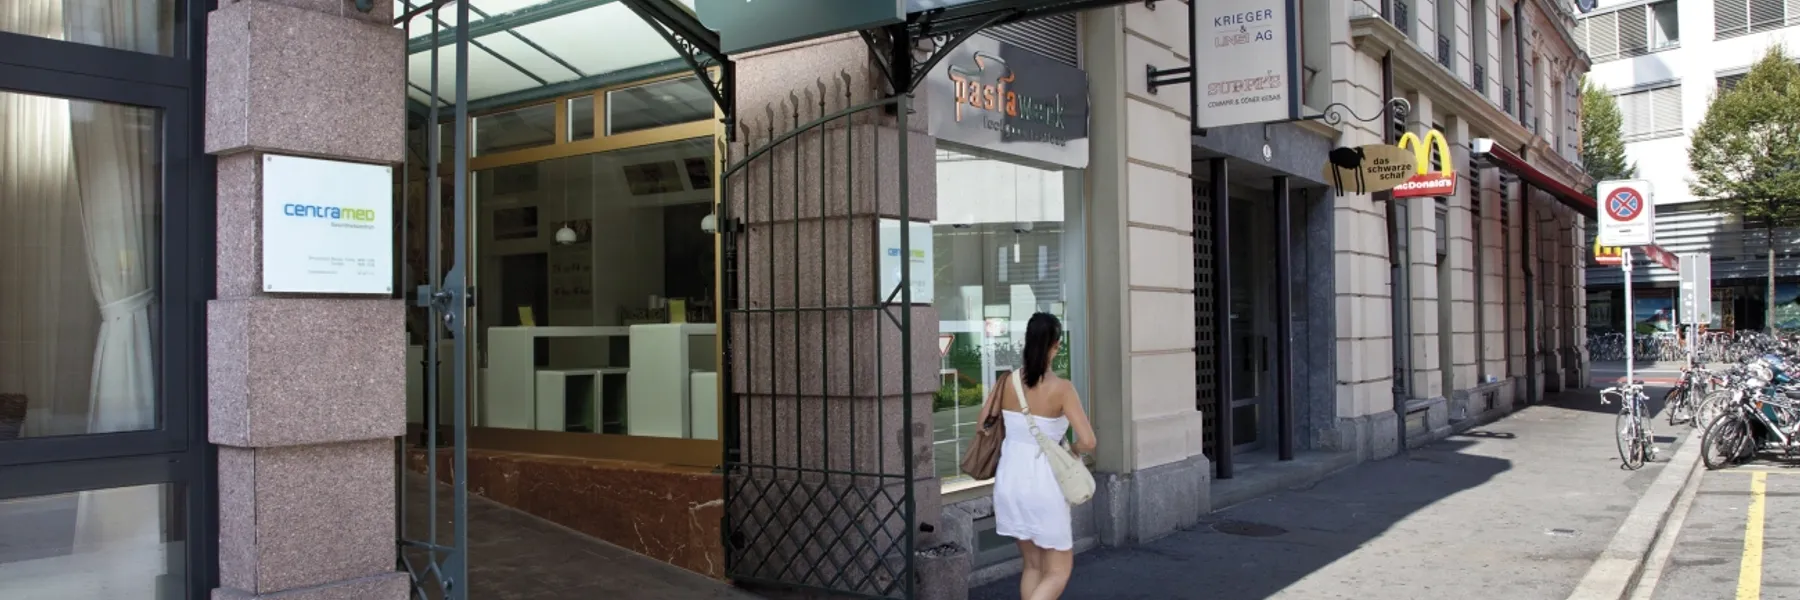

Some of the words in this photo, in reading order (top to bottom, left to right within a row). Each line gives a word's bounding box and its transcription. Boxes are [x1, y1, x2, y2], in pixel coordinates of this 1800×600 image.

[1214, 9, 1272, 27] KRIEGER
[1240, 25, 1247, 33] &
[1255, 29, 1273, 41] AG
[1367, 163, 1412, 173] schwarze
[1380, 171, 1405, 180] schaf
